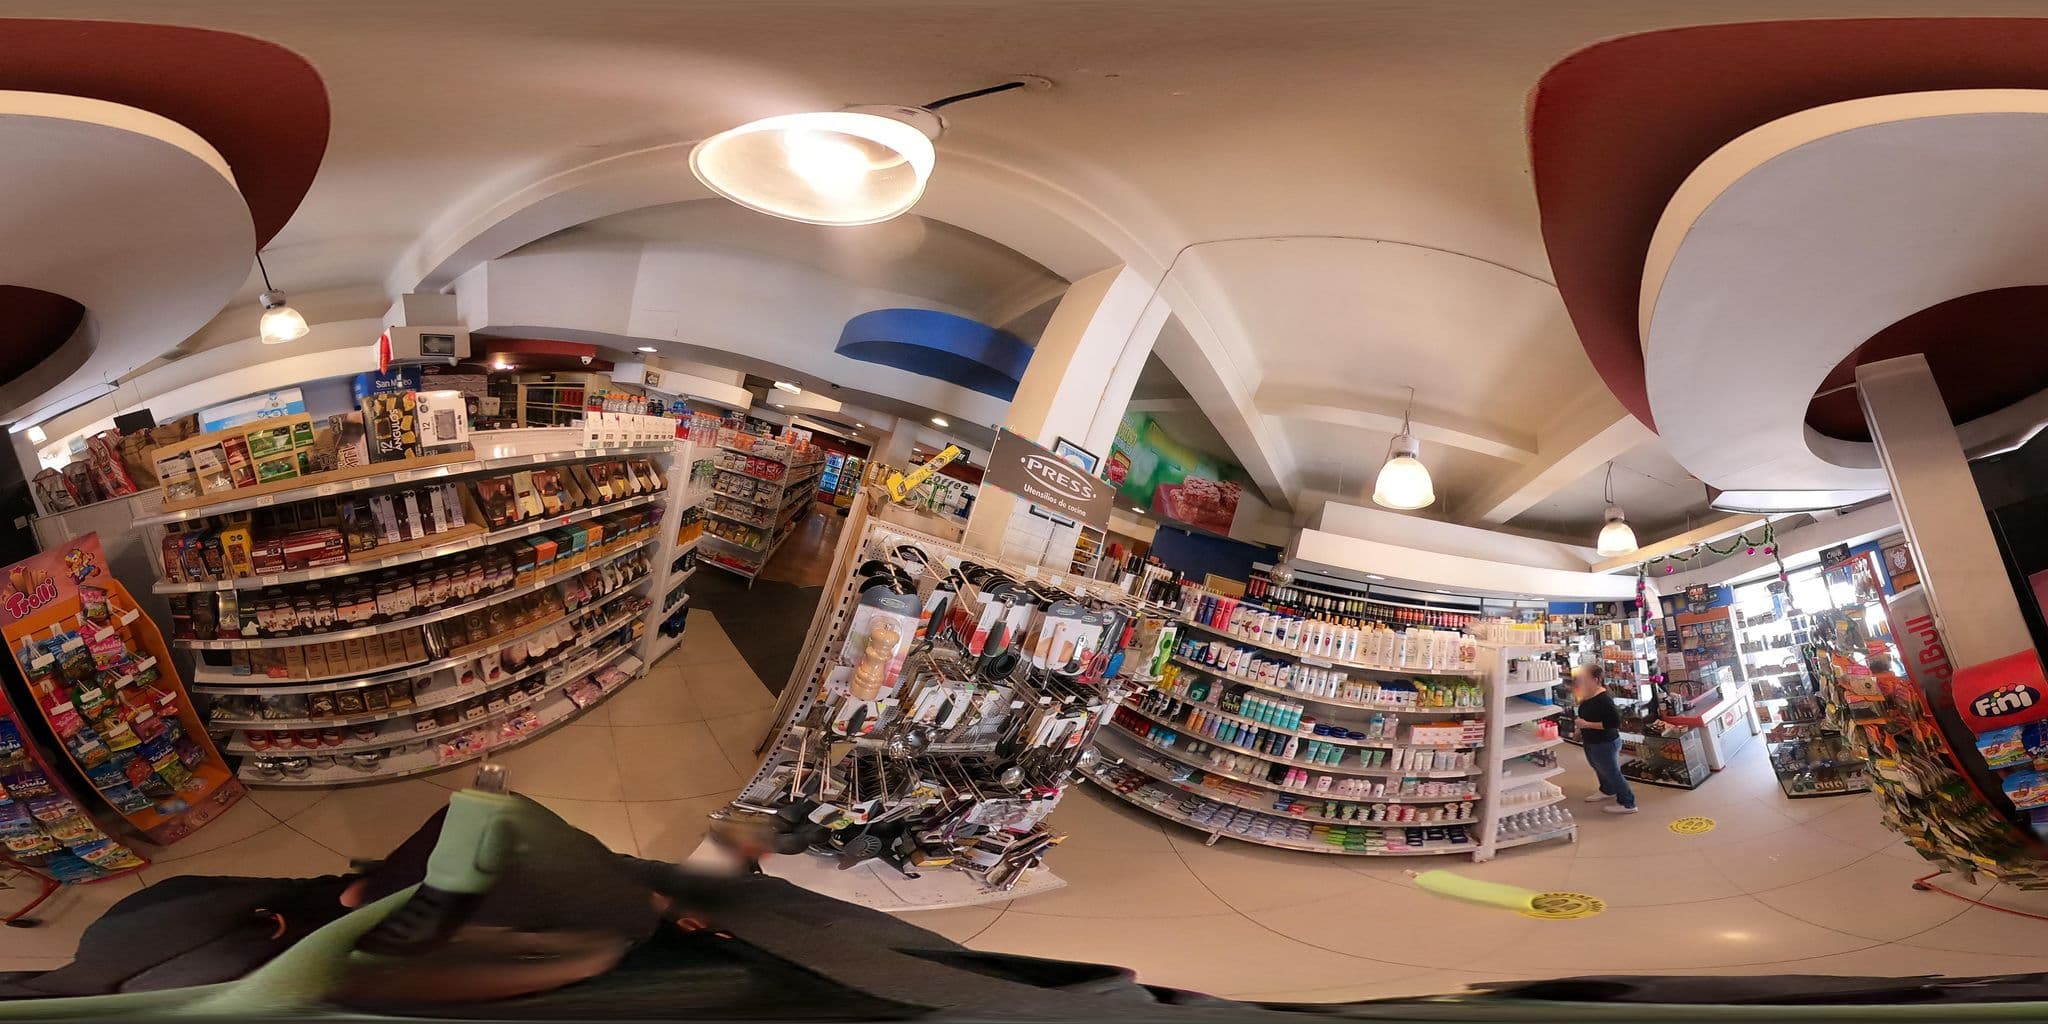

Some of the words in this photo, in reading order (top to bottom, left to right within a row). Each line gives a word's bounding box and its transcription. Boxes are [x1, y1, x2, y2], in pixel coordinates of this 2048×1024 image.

[375, 380, 391, 389] San
[391, 379, 412, 388] Meo
[380, 440, 393, 454] 12
[927, 475, 969, 492] offee
[1027, 457, 1092, 498] PRESS
[1023, 483, 1057, 504] Utensilios
[1058, 499, 1067, 508] de
[5, 578, 58, 619] Trolli
[1904, 614, 1945, 665] Bull
[1975, 684, 2033, 717] Fini
